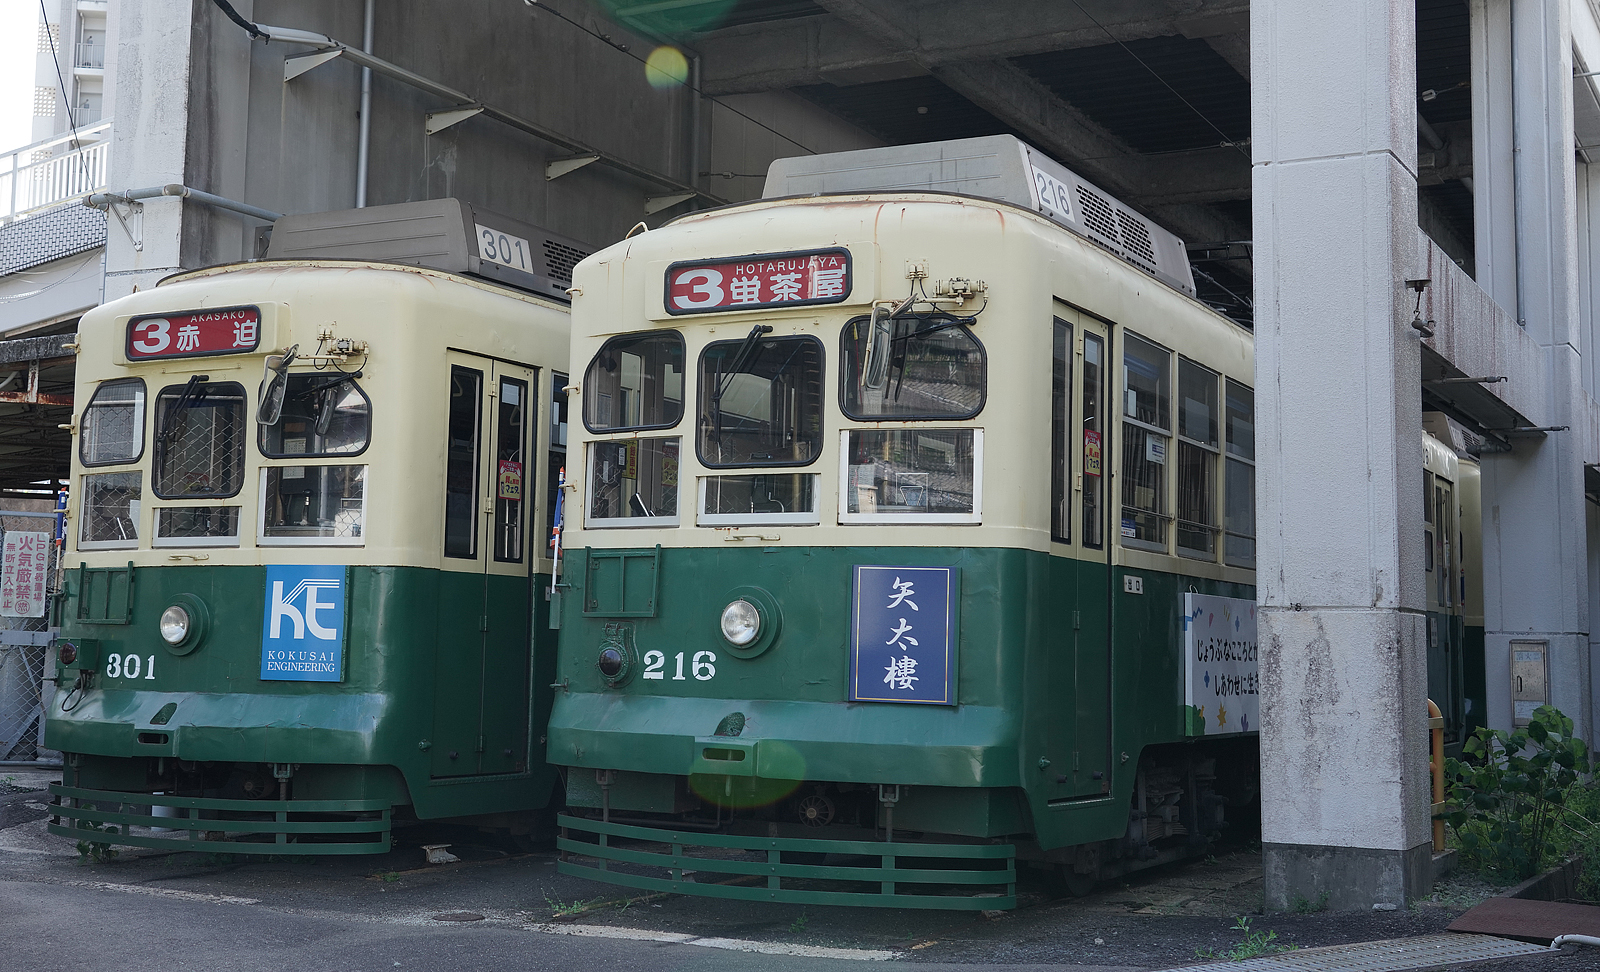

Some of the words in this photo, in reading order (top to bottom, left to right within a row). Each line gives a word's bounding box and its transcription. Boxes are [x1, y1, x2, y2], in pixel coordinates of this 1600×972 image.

[1036, 172, 1070, 215] 216
[482, 229, 525, 269] 301
[735, 256, 839, 276] HOTARUJAYA
[673, 268, 725, 309] 3
[190, 310, 245, 323] AKASAKO
[133, 318, 171, 354] 3
[2, 542, 16, 609] 無断立入禁止
[16, 535, 33, 600] 火気厳禁
[106, 653, 156, 680] 301
[266, 661, 336, 672] ENGINEERING
[267, 650, 335, 661] KOKUSAI
[642, 649, 717, 681] 216
